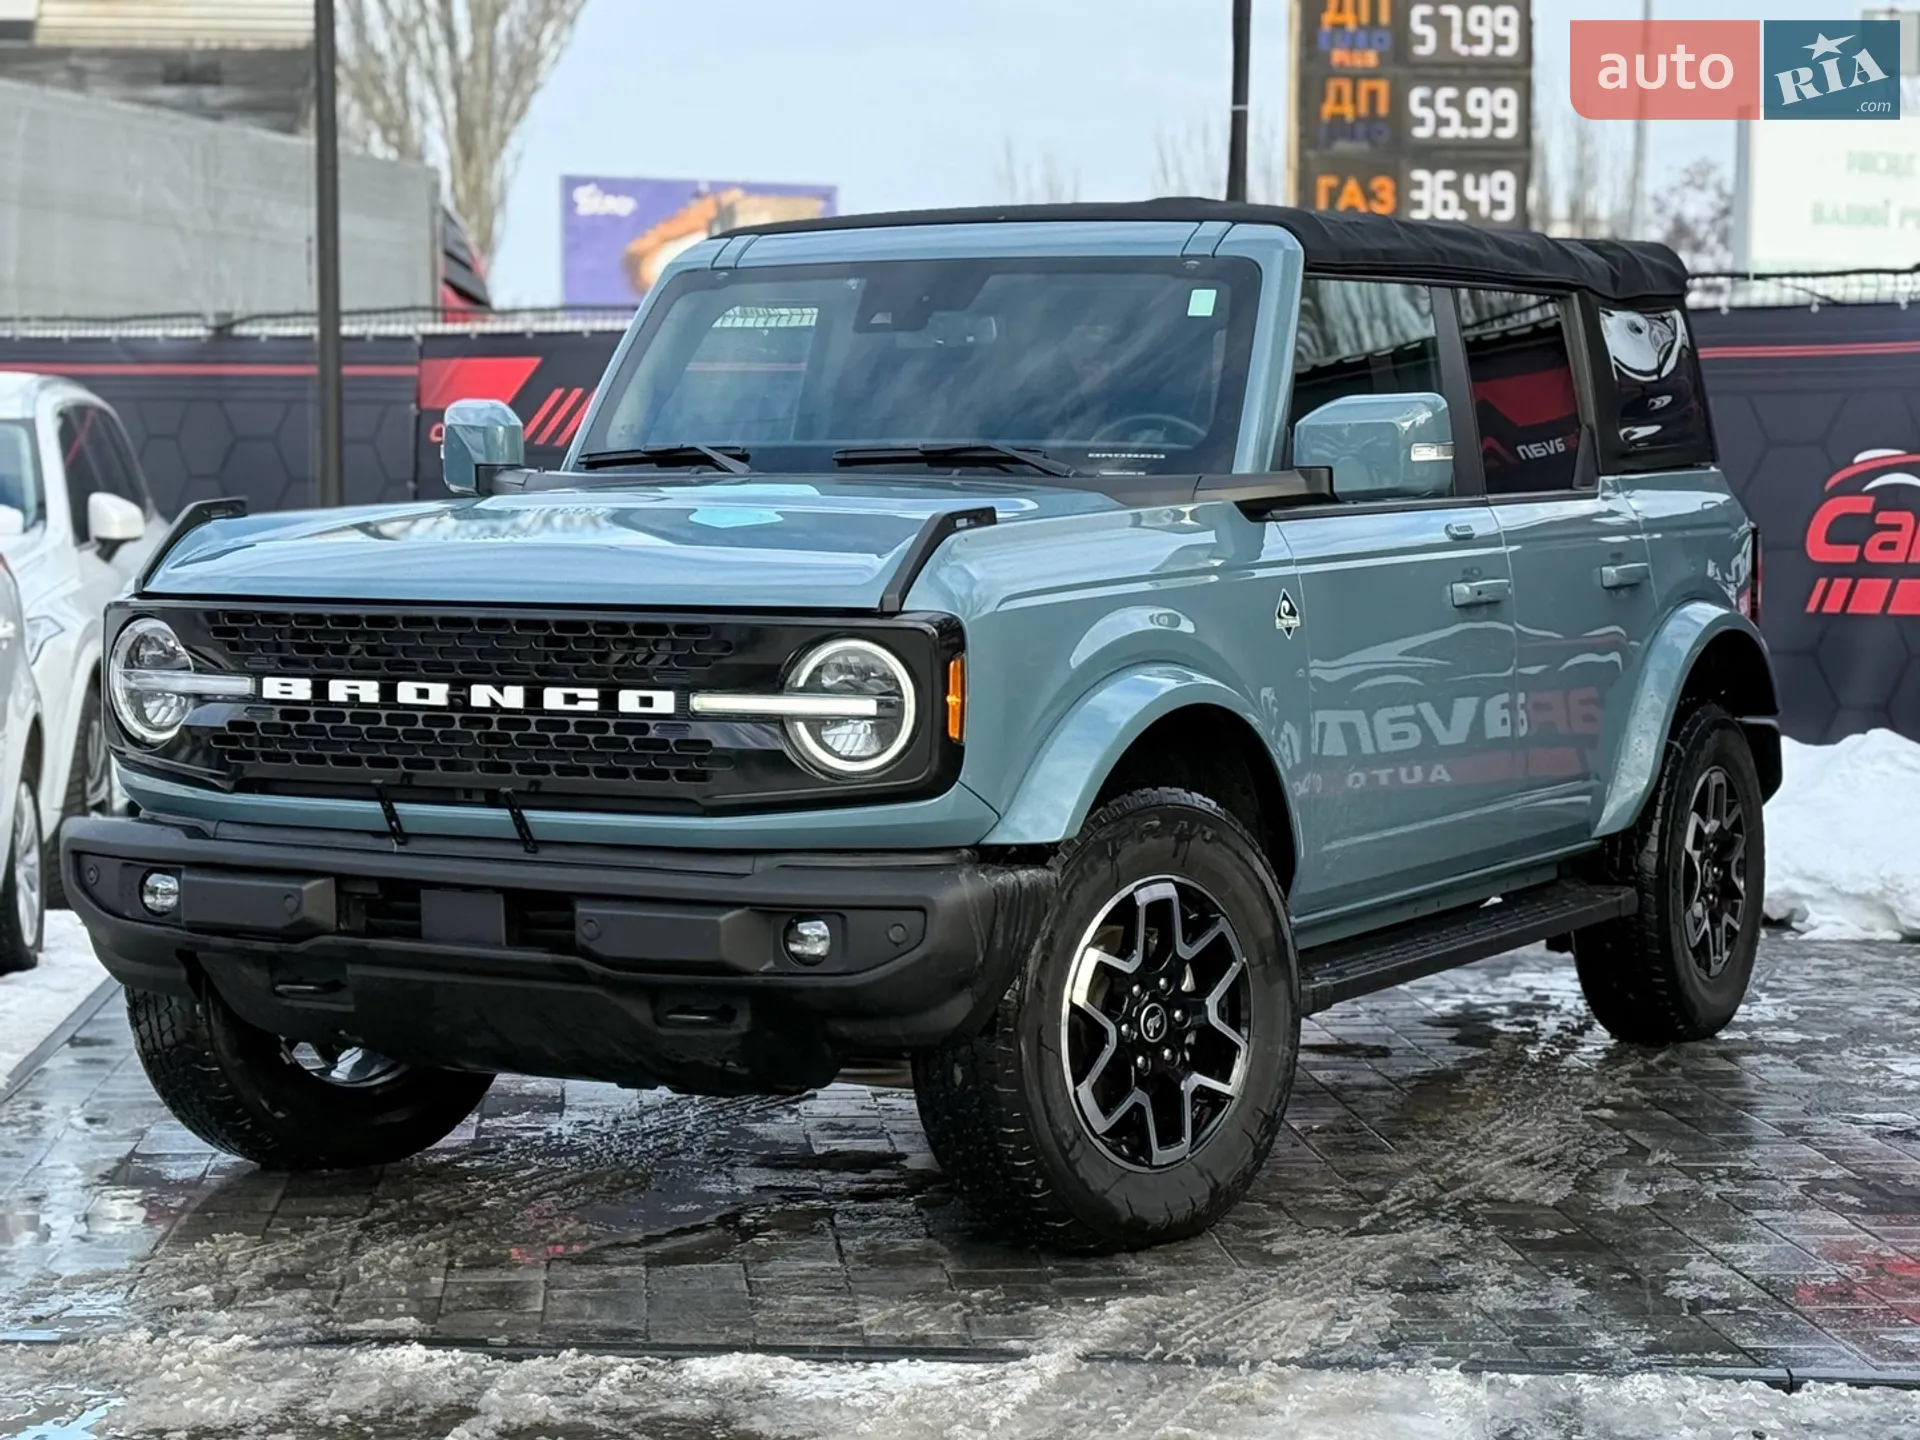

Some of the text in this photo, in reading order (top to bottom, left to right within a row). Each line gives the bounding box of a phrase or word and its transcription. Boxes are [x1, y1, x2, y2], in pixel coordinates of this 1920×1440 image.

[1409, 4, 1519, 57] 57.99
[1320, 77, 1390, 122] ДП
[1408, 86, 1518, 139] 55.99
[1315, 174, 1396, 215] ГАЗ
[1409, 169, 1517, 221] 36.49
[262, 676, 676, 714] BRONCO
